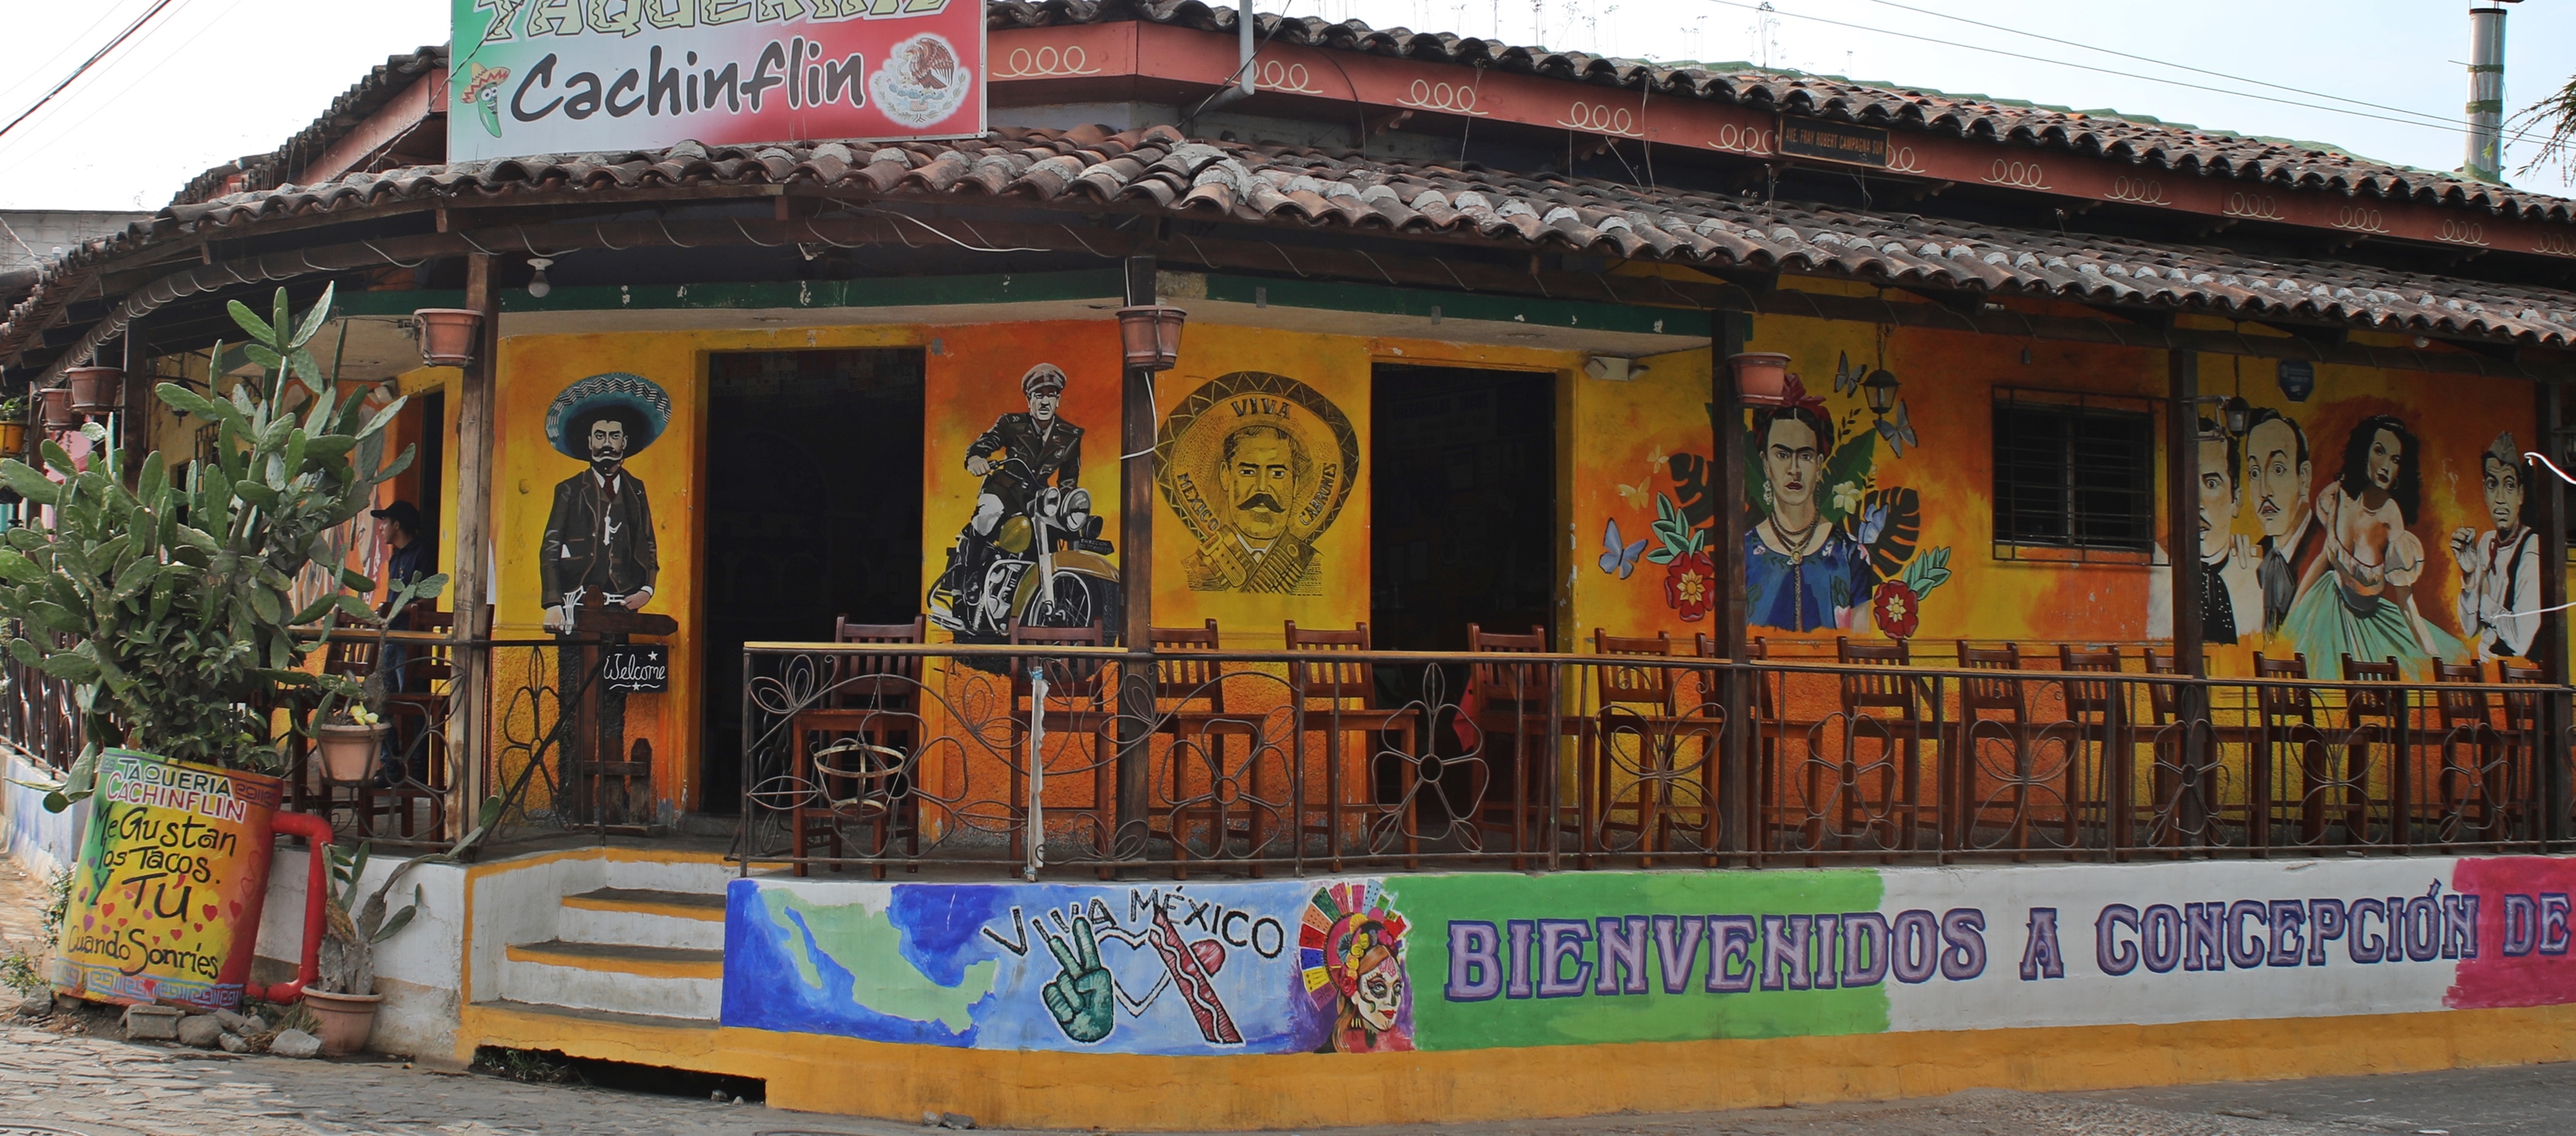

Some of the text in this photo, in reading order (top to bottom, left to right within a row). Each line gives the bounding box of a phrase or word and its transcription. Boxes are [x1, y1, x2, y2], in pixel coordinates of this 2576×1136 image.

[478, 0, 951, 41] TAQUE
[510, 40, 865, 123] Cachinflin
[1800, 129, 1816, 145] FRAY
[1231, 398, 1292, 419] VIVA
[1177, 471, 1220, 531] MEXICO
[1299, 462, 1337, 526] CABRONES
[603, 653, 666, 680] Welcome
[107, 772, 245, 821] CACHINFLIN
[119, 759, 231, 797] TAQUERIA
[90, 802, 237, 857] Me Gustan
[67, 925, 130, 960] Cuando
[983, 886, 1284, 959] VIVA MÉXICO
[1445, 878, 2572, 1002] BIENVENIDOS A CONCEPCIÓN DE
